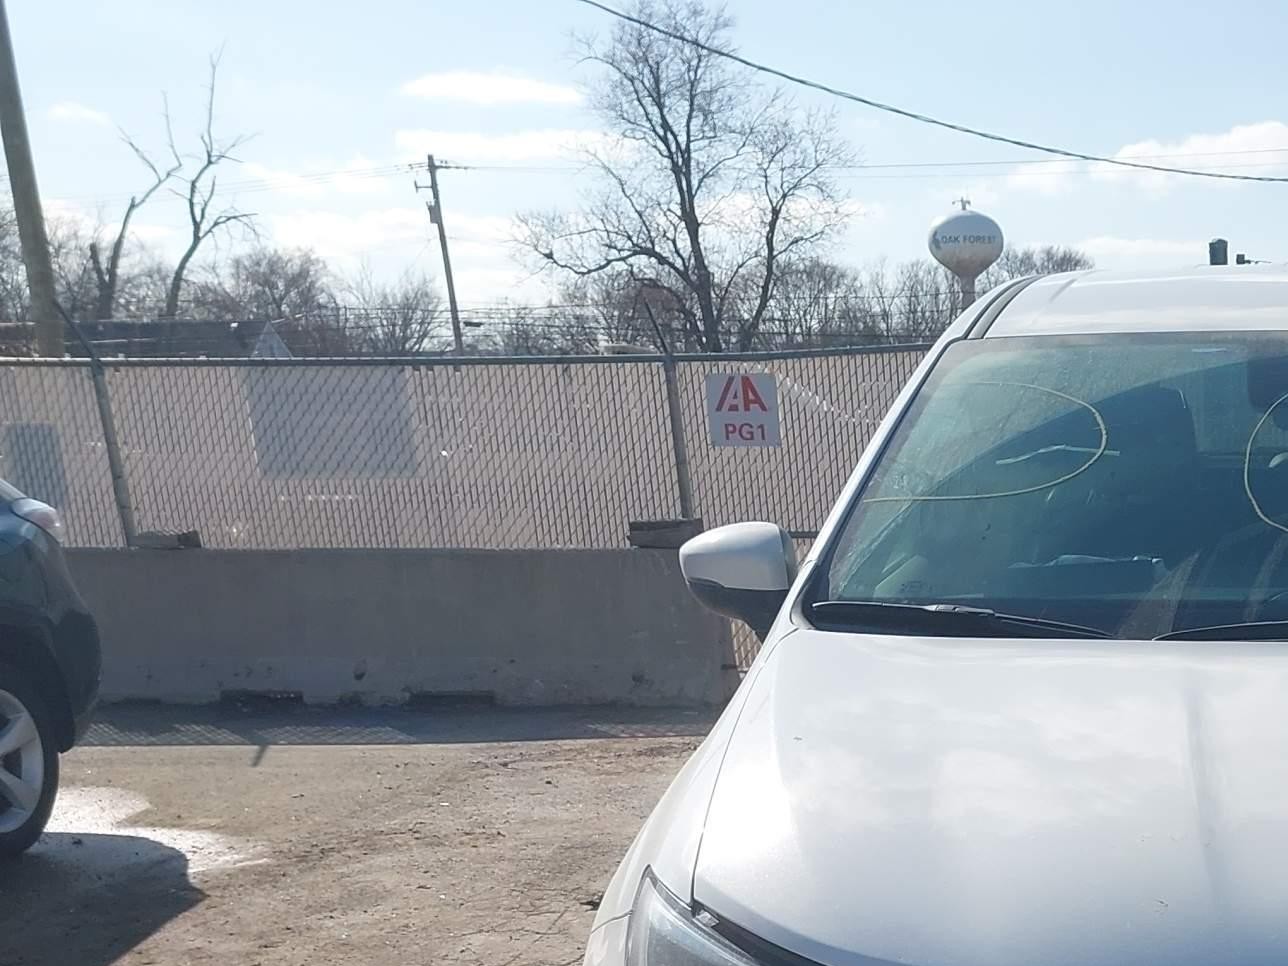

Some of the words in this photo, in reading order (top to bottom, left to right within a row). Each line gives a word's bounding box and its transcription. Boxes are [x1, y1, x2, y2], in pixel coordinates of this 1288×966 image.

[941, 234, 960, 244] OAK
[962, 234, 997, 244] FOREST
[724, 422, 766, 441] PG1
